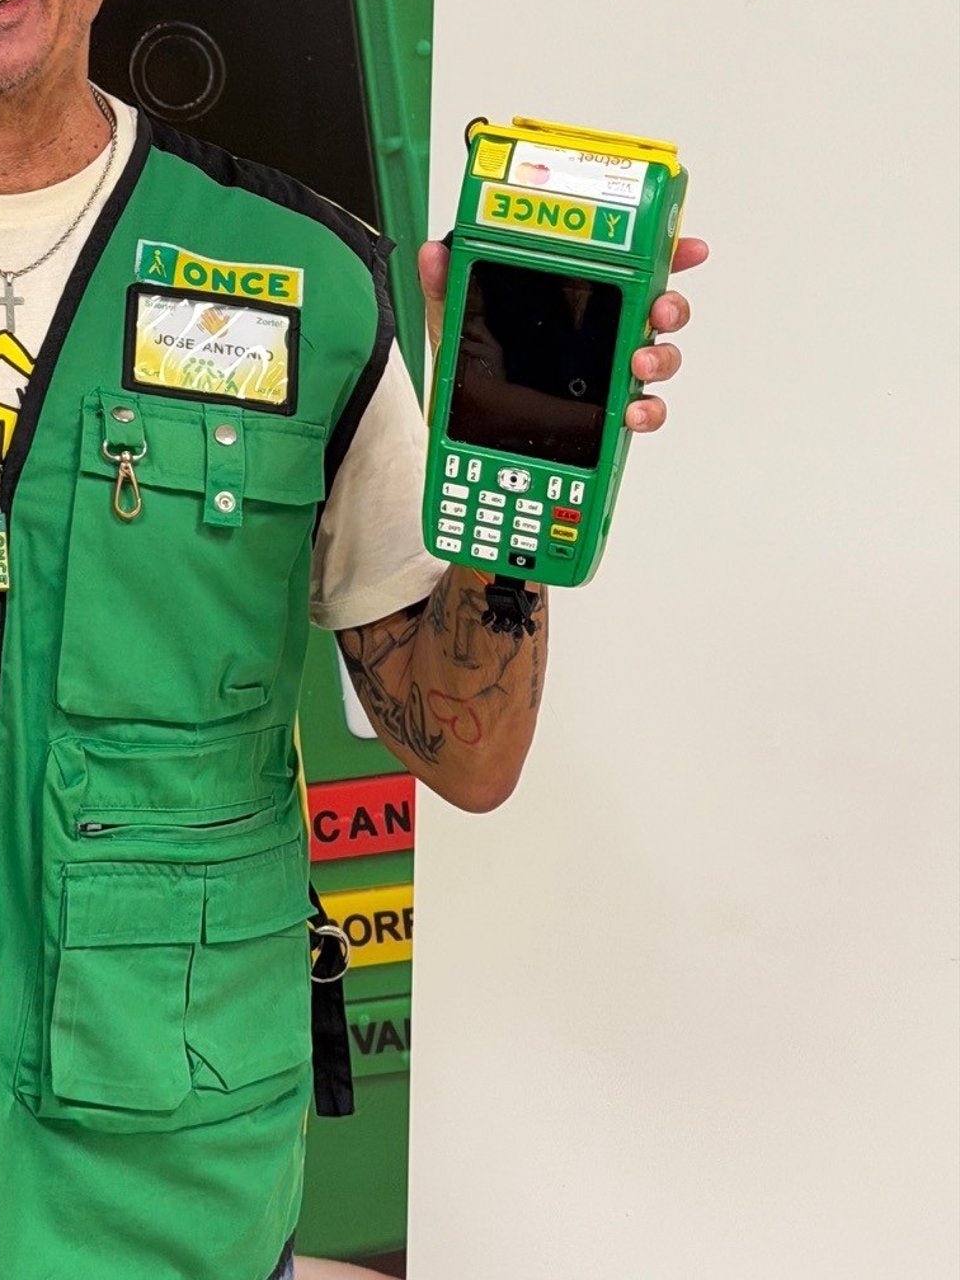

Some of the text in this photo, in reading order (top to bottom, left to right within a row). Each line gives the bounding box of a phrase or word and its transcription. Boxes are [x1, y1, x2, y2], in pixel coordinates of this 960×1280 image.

[492, 193, 586, 230] ONCE
[183, 261, 291, 298] ONCE
[154, 333, 195, 350] JOSE
[480, 493, 487, 501] 2
[441, 504, 447, 512] 4
[517, 500, 524, 509] 3
[478, 511, 485, 520] 5
[514, 519, 521, 528] 6
[475, 529, 482, 538] 8
[512, 537, 519, 546] 9
[312, 800, 412, 844] CAN
